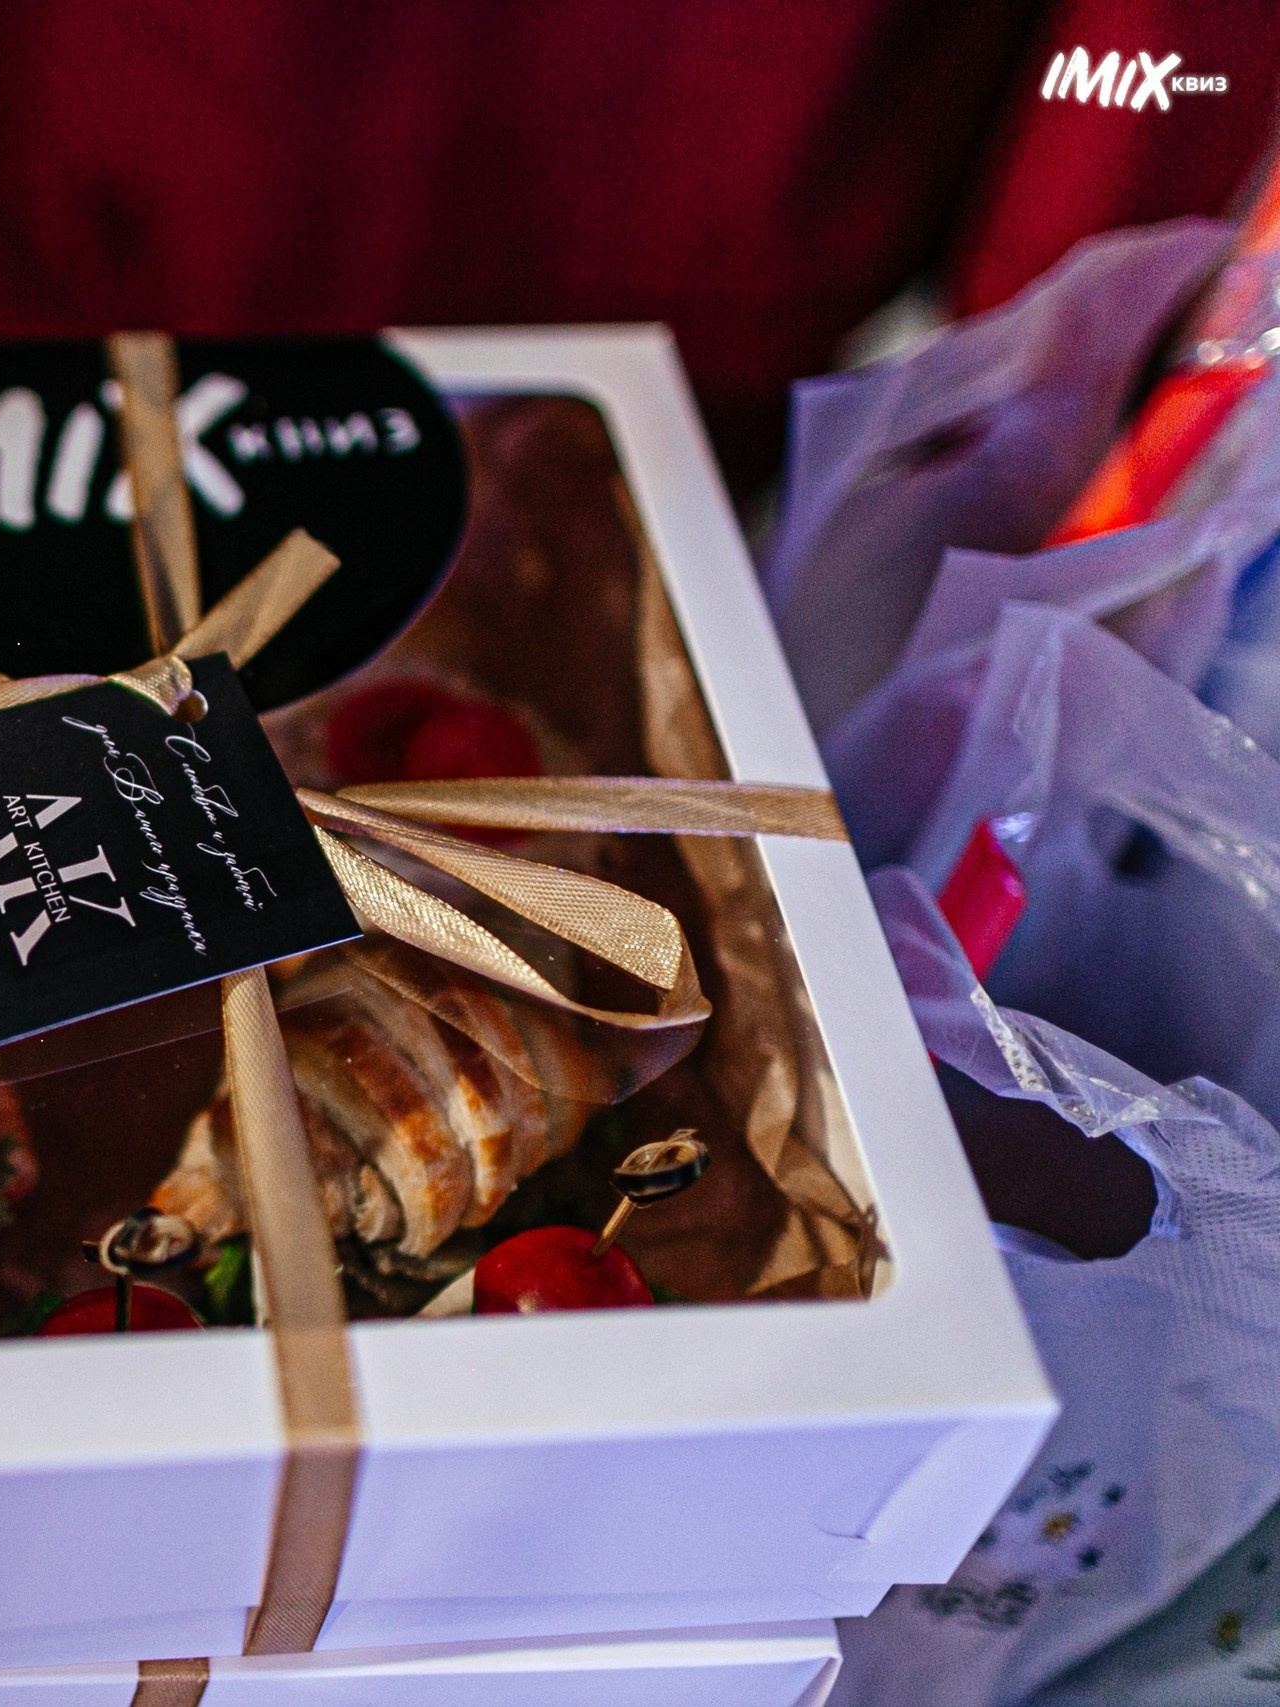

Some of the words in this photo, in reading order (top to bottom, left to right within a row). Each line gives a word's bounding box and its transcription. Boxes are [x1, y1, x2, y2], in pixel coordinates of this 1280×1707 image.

[3, 794, 33, 828] ART
[23, 841, 72, 924] KITCHEN
[104, 752, 164, 864] Вашего
